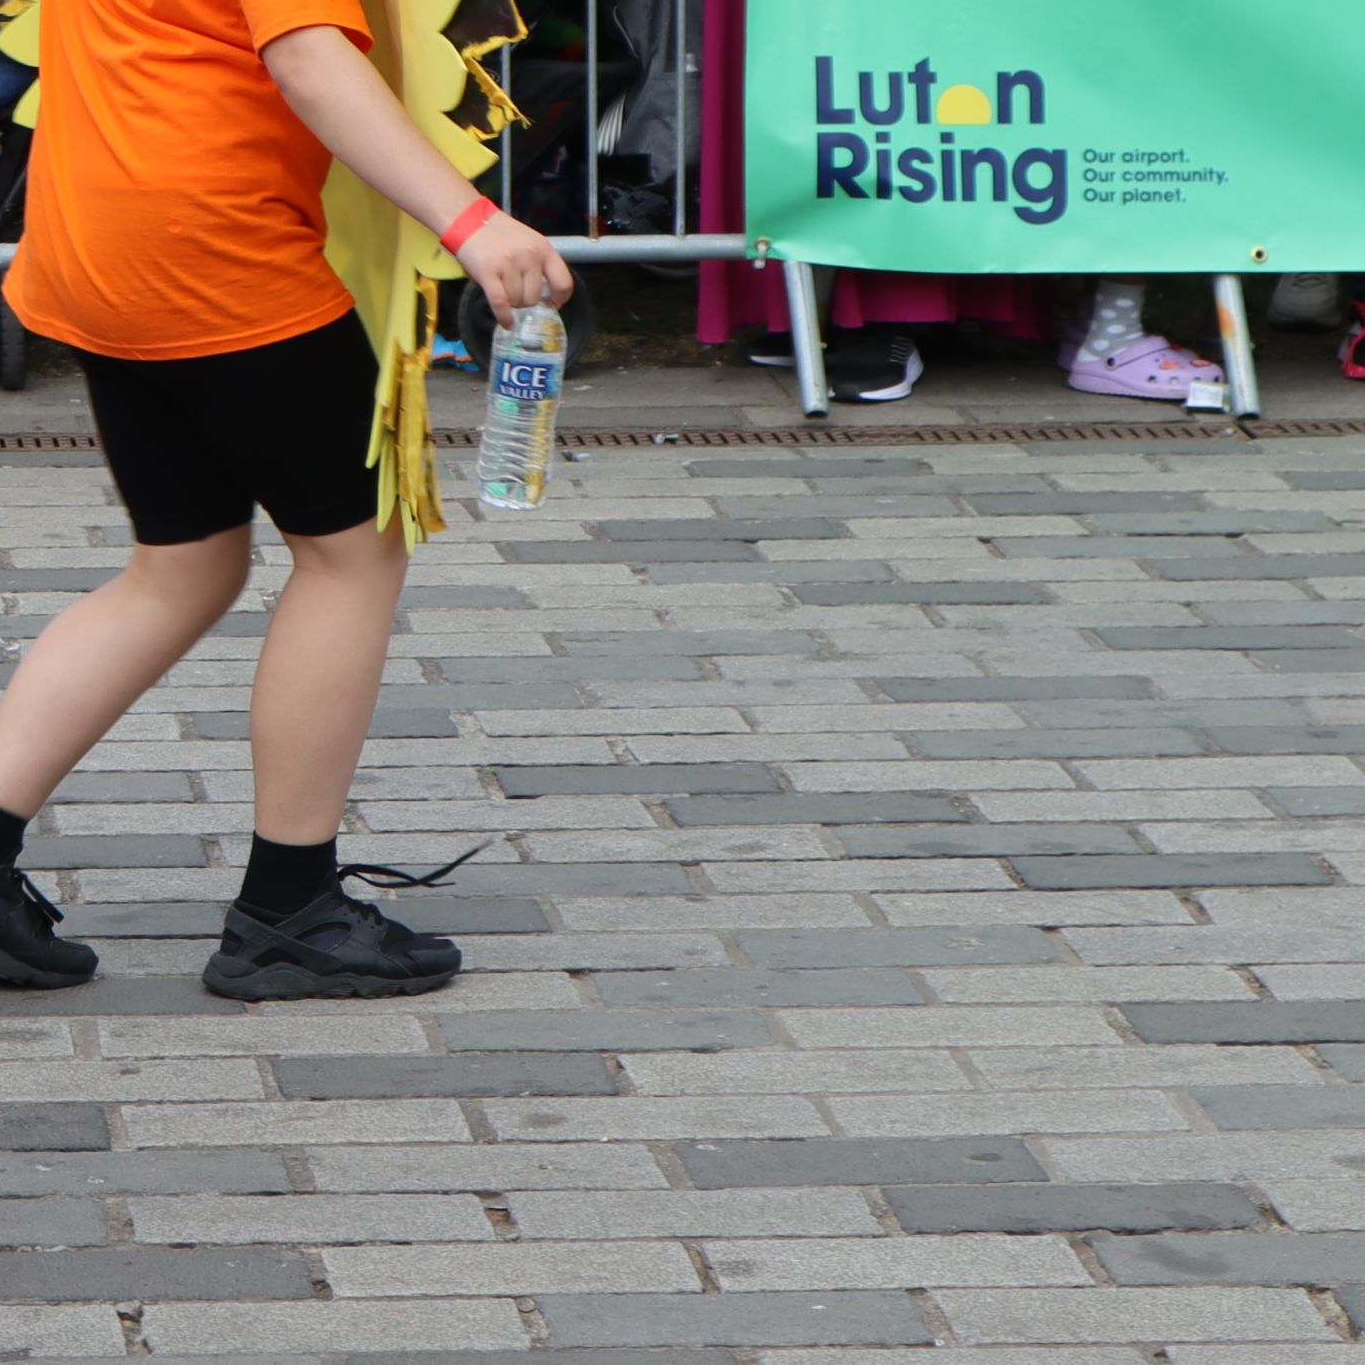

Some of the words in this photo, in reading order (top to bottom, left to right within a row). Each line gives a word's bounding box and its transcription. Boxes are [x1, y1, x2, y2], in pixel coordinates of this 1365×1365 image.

[1082, 148, 1116, 165] Our
[1121, 146, 1191, 170] airport.
[815, 131, 1068, 225] Rising
[1082, 167, 1116, 184] Our
[1121, 165, 1230, 189] community.
[1082, 187, 1116, 204] Our
[1121, 185, 1187, 209] planet.
[502, 362, 549, 389] ICE
